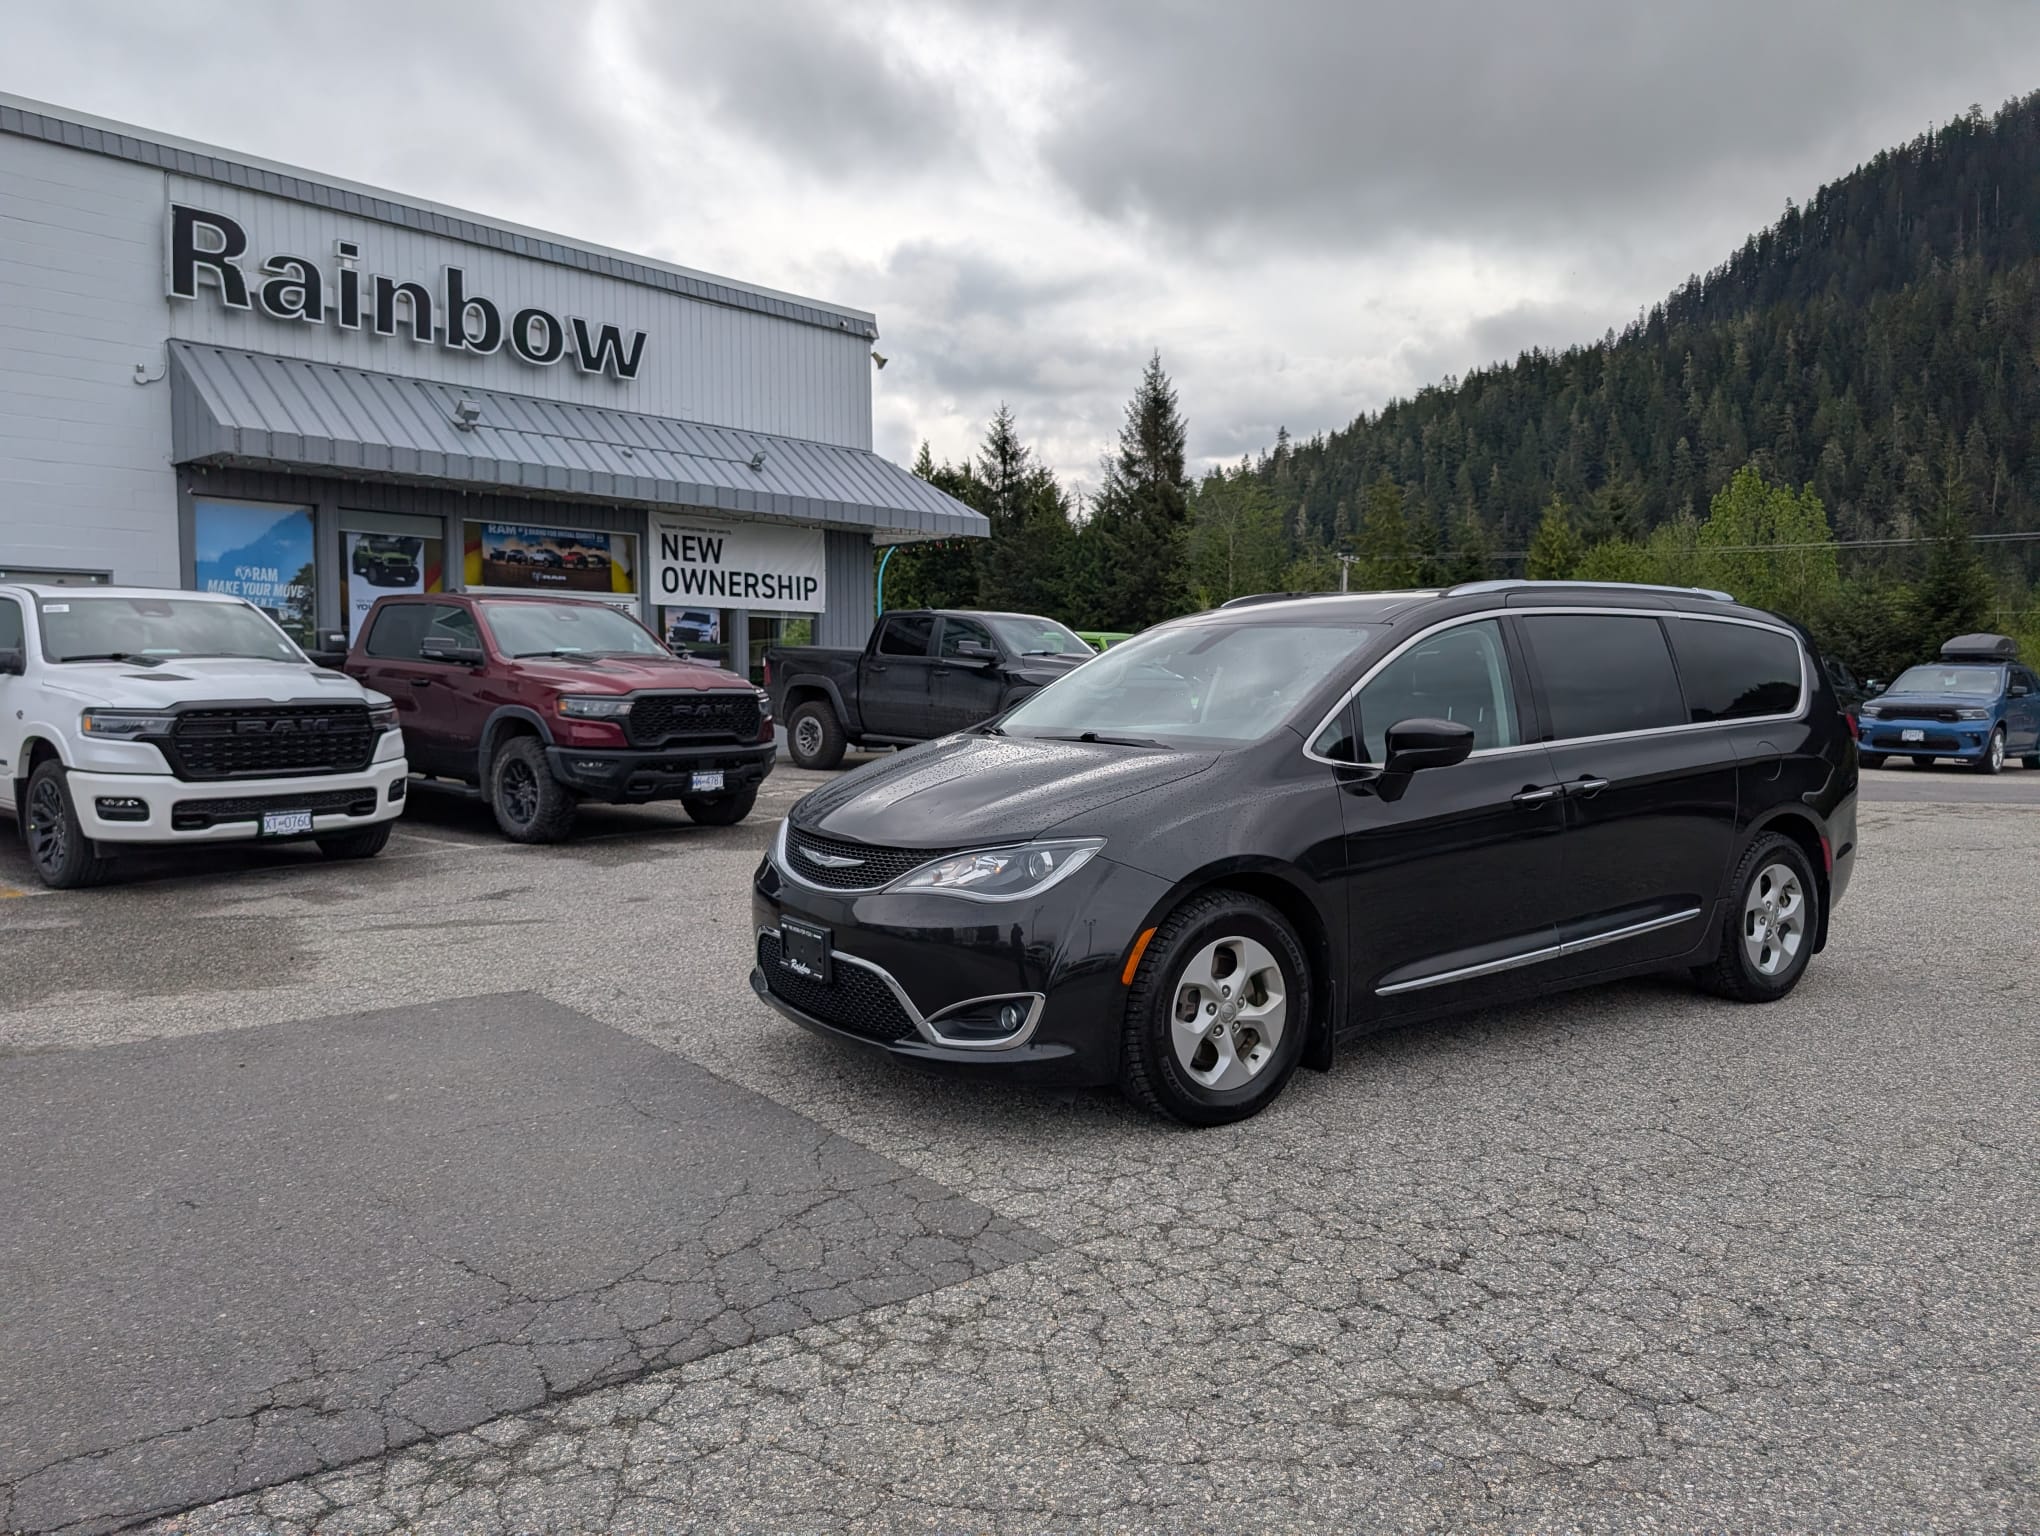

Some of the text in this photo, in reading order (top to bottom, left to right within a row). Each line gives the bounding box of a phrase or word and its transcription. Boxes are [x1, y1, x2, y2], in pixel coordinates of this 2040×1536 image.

[168, 201, 648, 381] Rainbow
[661, 533, 723, 564] NEW
[208, 579, 304, 598] MAKE YOUR MOVE
[252, 567, 278, 582] RAM
[662, 566, 818, 601] OWNERSHIP
